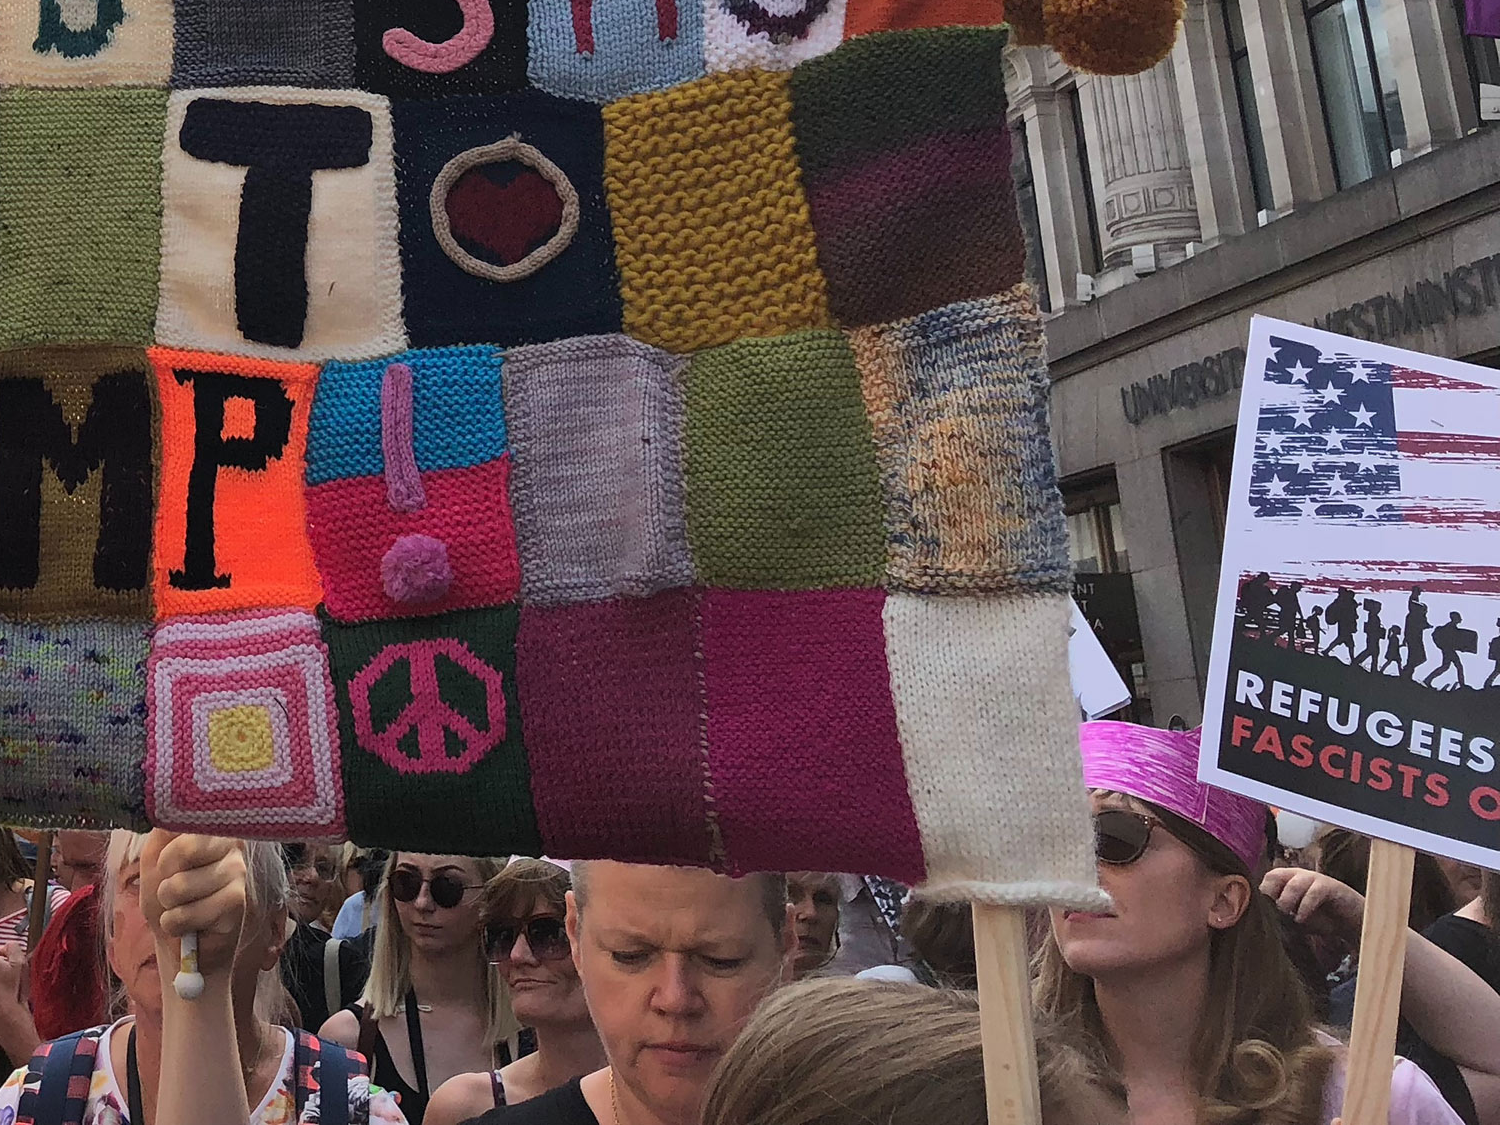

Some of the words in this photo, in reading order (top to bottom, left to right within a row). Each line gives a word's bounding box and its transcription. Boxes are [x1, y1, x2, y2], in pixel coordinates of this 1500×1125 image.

[179, 96, 580, 349] TO
[1121, 346, 1247, 426] UNIVERSIT
[1231, 715, 1450, 807] FASCISTS
[1235, 670, 1495, 773] REFUGEES
